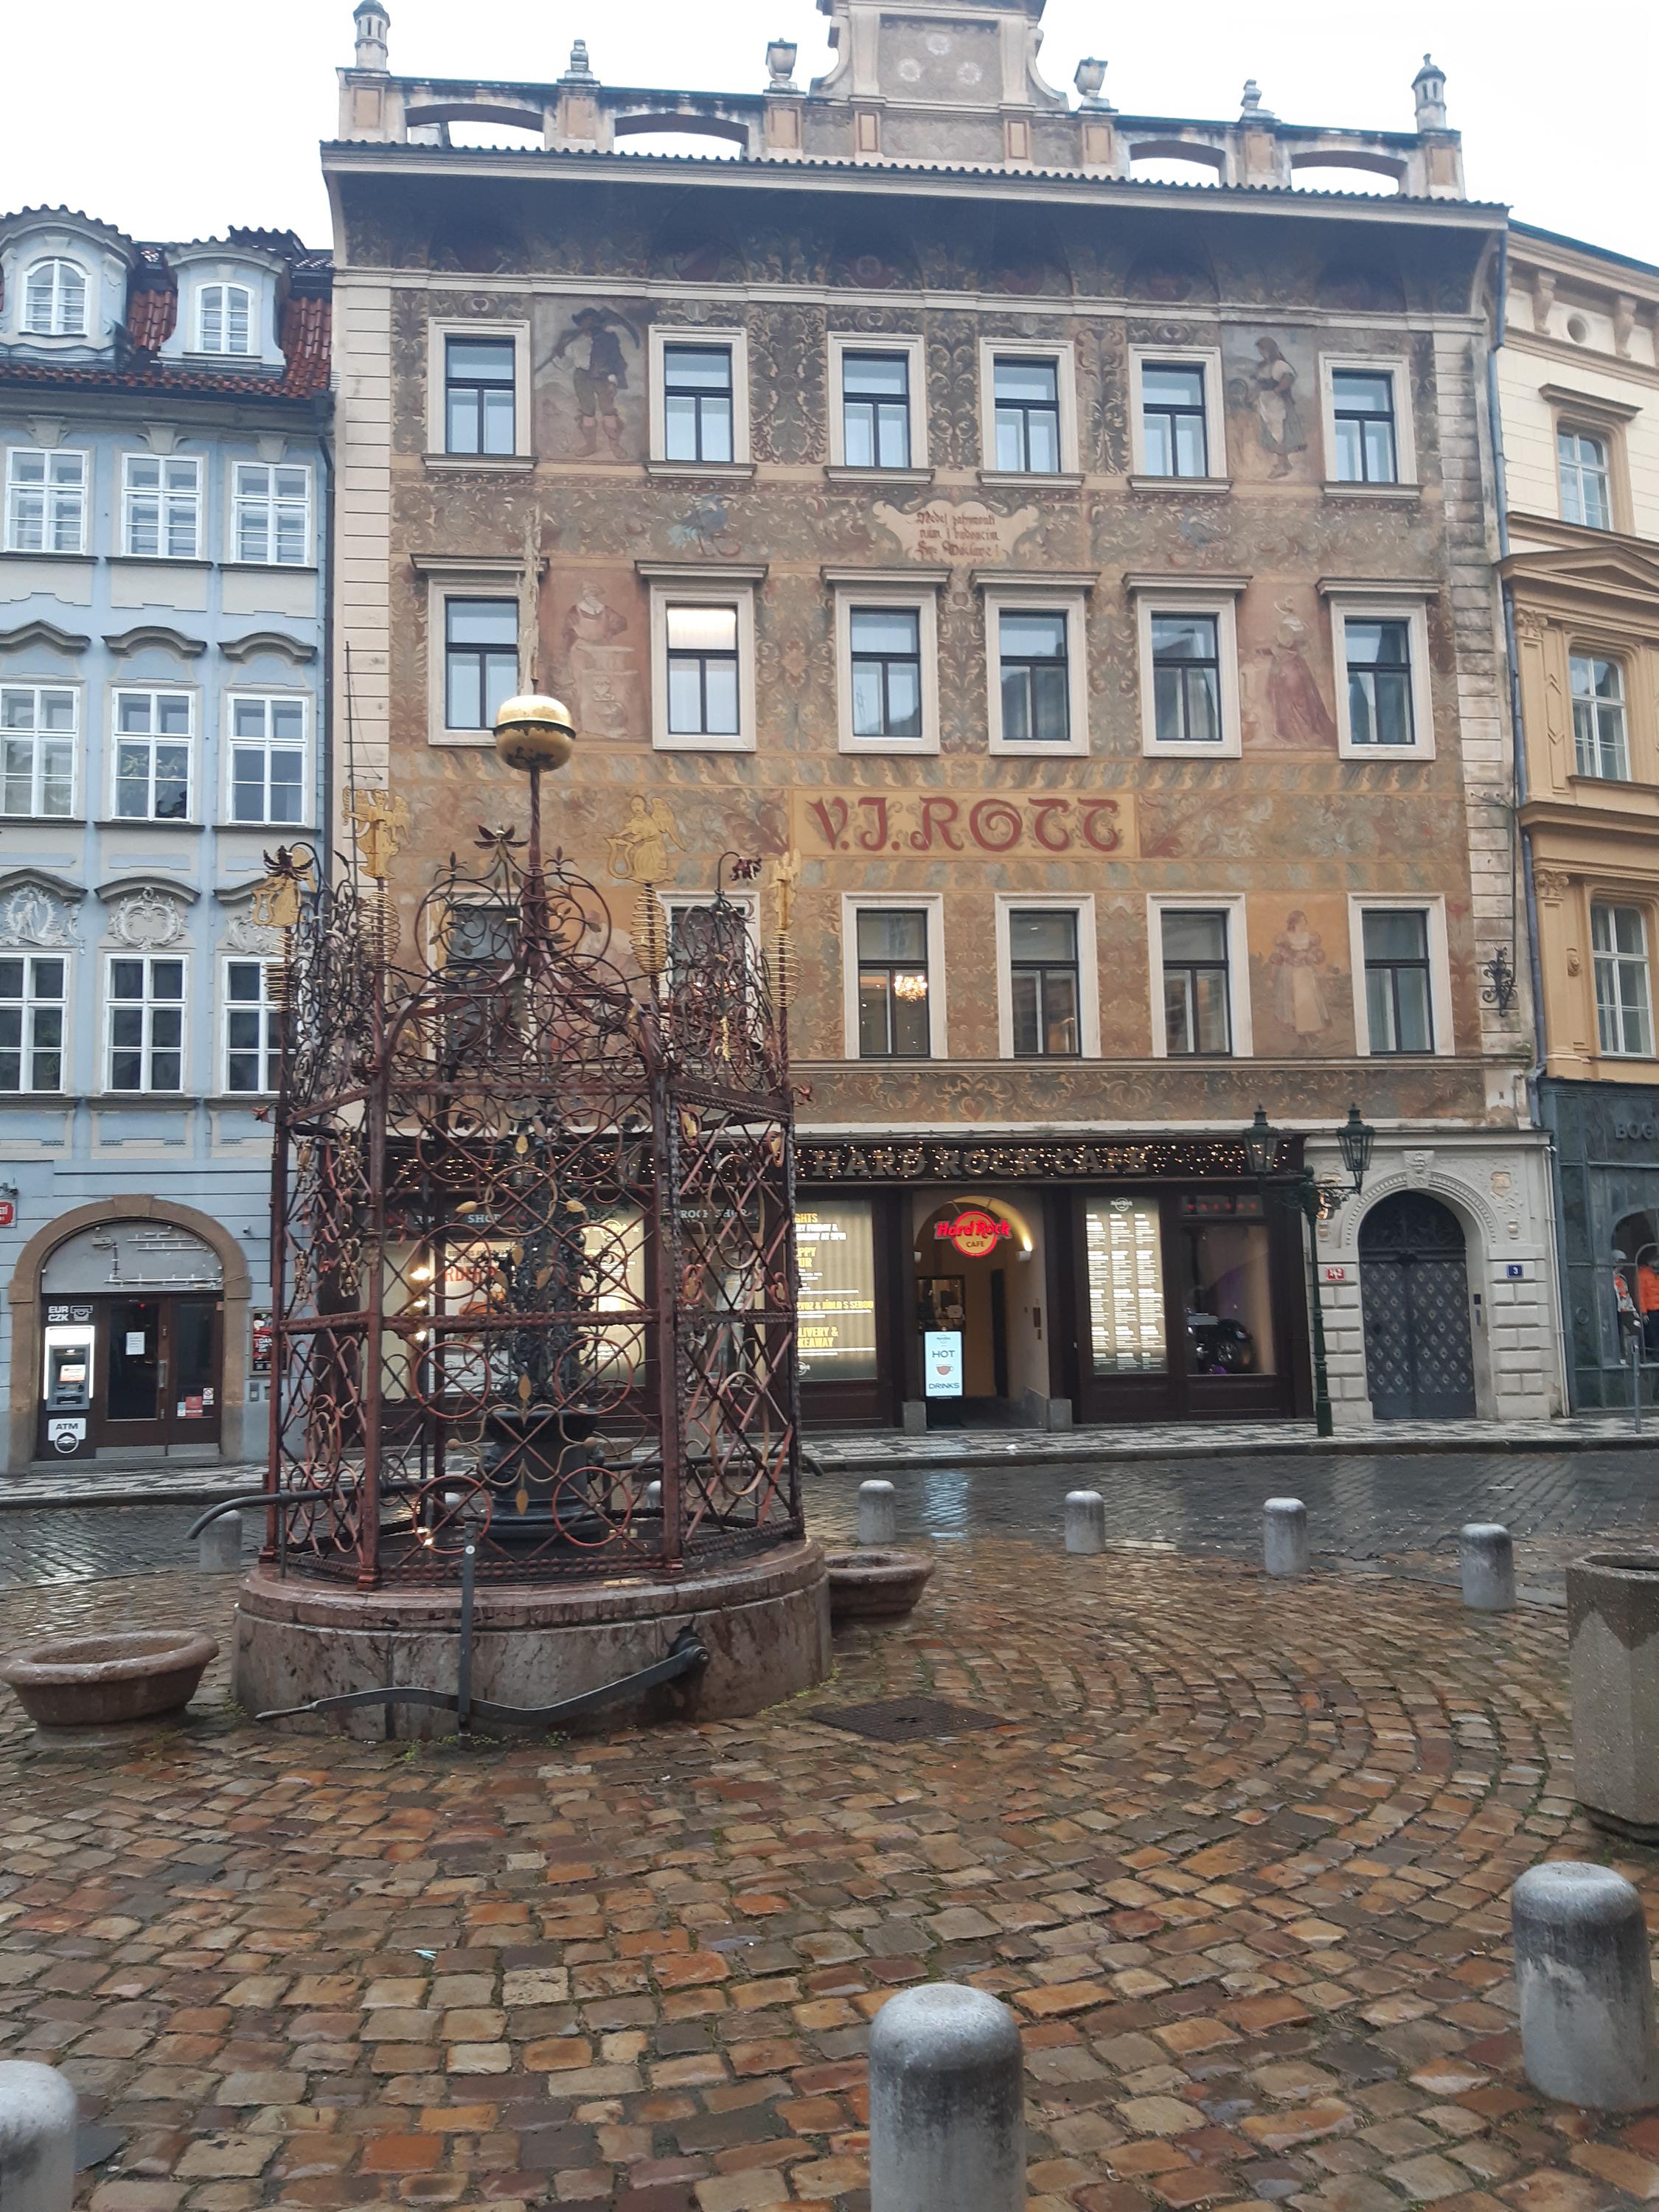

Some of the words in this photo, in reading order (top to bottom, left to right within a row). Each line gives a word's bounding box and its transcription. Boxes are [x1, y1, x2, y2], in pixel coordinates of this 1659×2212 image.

[1615, 1121, 1659, 1140] BOG
[812, 1150, 926, 1178] HARD
[939, 1150, 1043, 1177] ROCK
[1054, 1147, 1147, 1175] CAFE
[795, 1213, 818, 1223] GHTS
[937, 1220, 973, 1237] Hard
[975, 1219, 1011, 1239] Rock
[796, 1247, 816, 1257] PPY
[798, 1258, 813, 1267] UR
[1512, 1266, 1519, 1274] 3
[48, 1306, 69, 1314] EUR
[797, 1326, 830, 1337] LIVERY
[797, 1338, 834, 1348] KEAWAY
[932, 1350, 955, 1358] HOT
